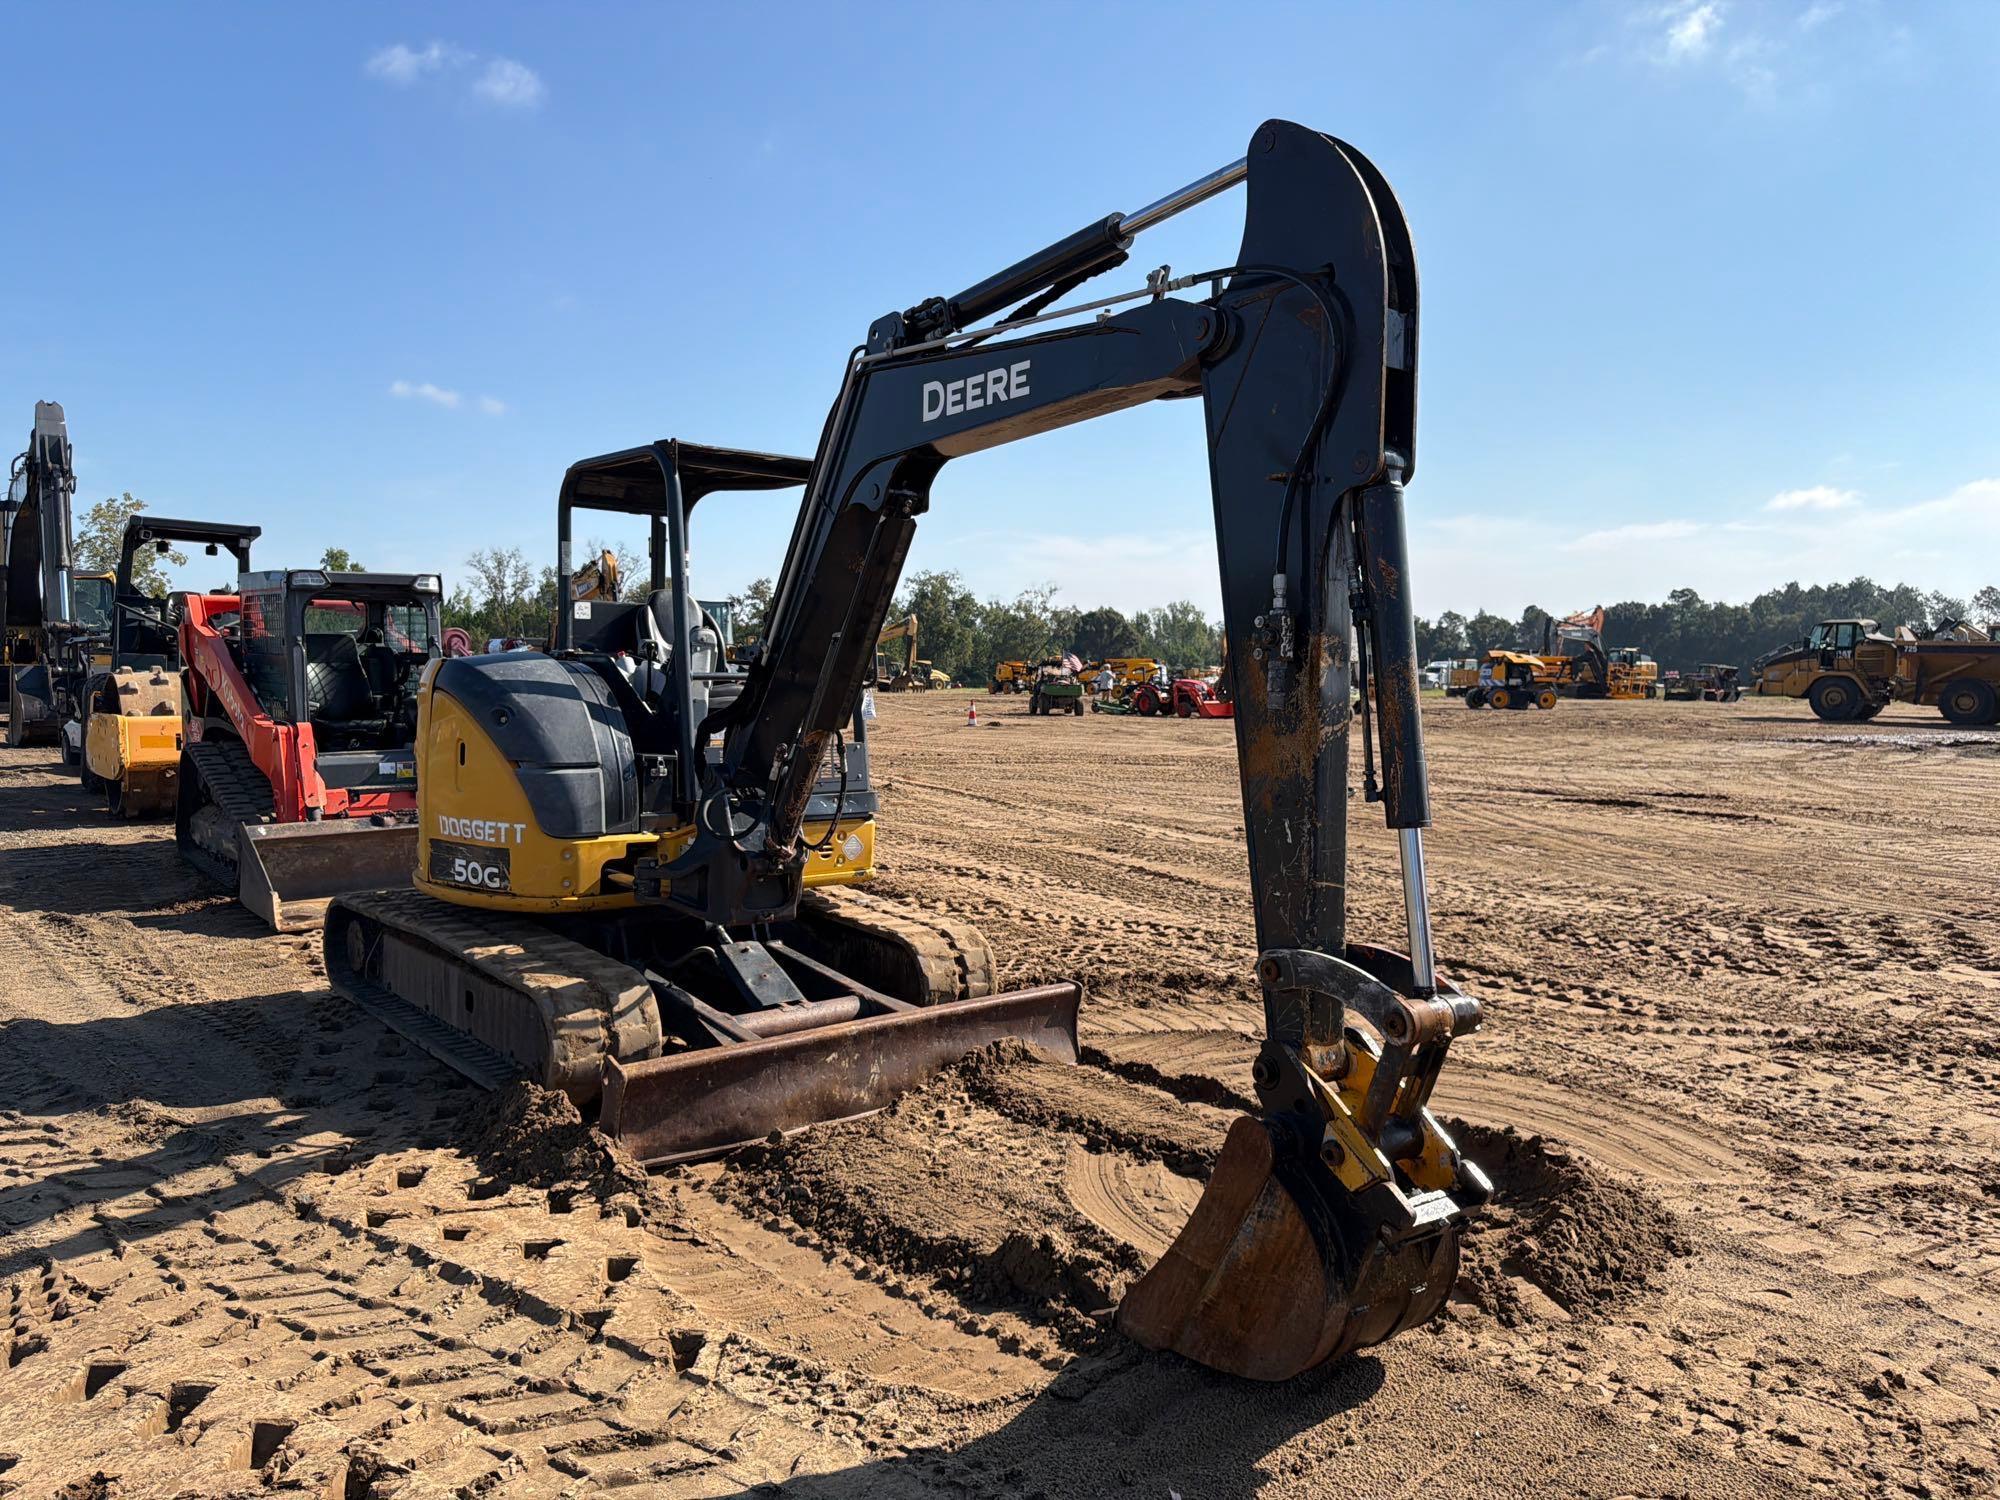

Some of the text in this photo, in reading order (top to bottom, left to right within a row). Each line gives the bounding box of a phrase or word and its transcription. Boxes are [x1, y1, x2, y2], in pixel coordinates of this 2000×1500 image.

[922, 359, 1031, 423] DEERE
[439, 815, 527, 844] DOGGETT
[454, 857, 501, 888] 50G
